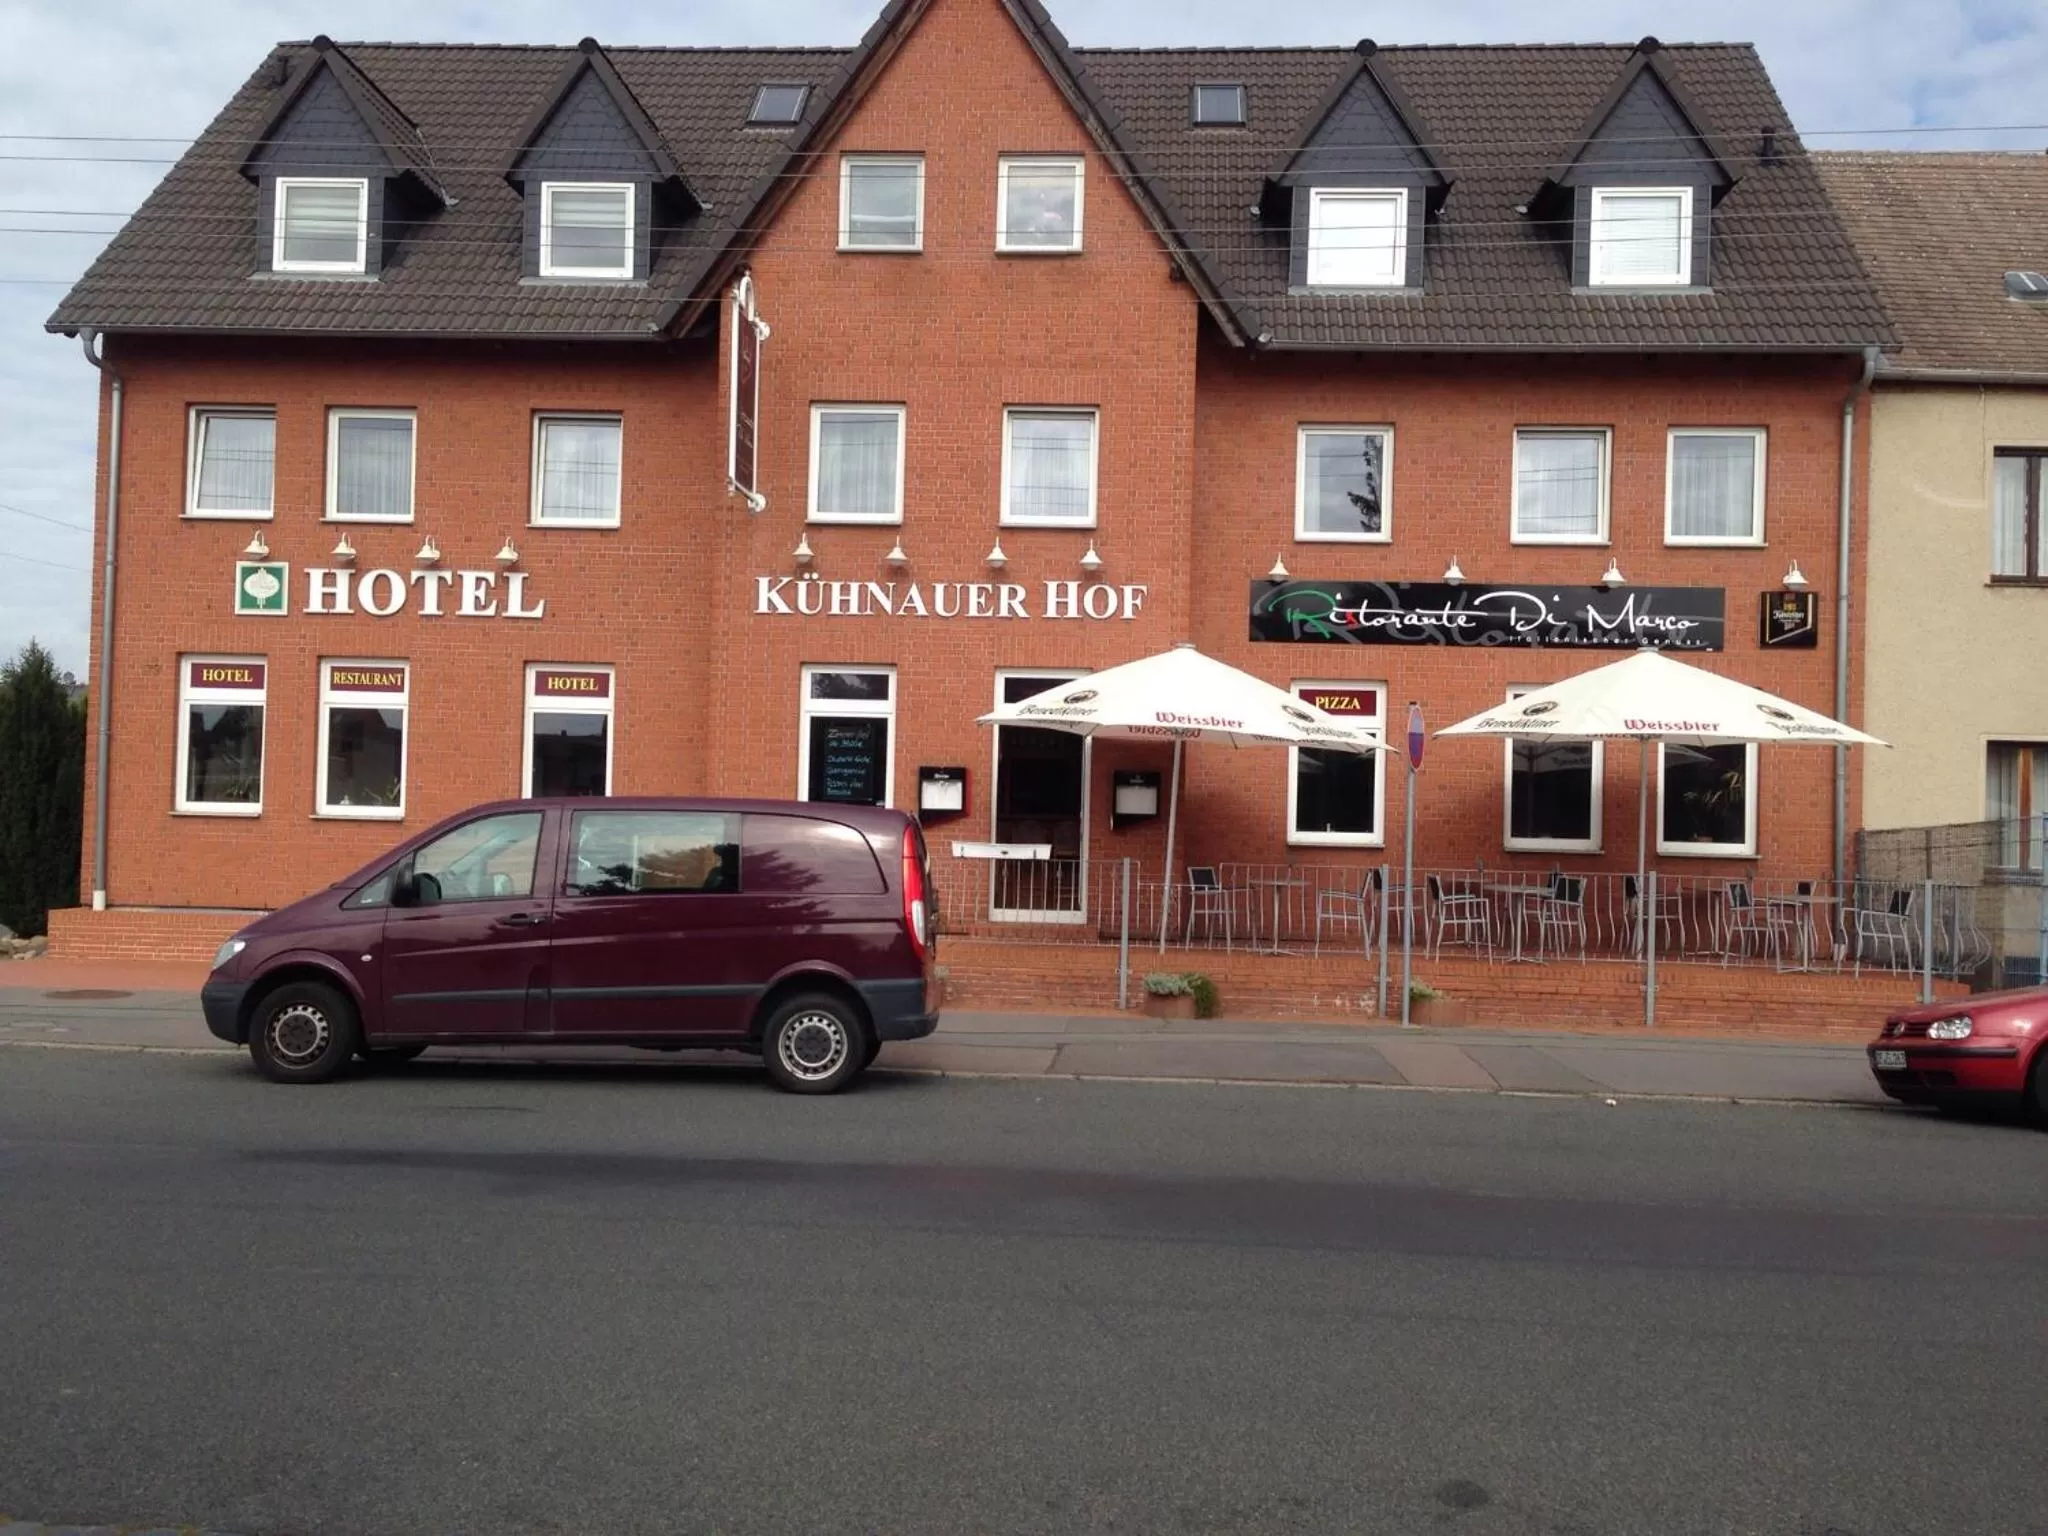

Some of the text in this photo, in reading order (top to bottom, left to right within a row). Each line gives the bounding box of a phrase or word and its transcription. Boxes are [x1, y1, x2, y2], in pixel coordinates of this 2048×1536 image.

[303, 567, 545, 618] HOTEL
[753, 571, 1149, 621] KÜHNAUER HOF
[1268, 589, 1699, 639] Ristorante Di Marco
[202, 668, 253, 683] HOTEL
[333, 671, 404, 687] RESTAURANT
[547, 676, 599, 691] HOTEL
[1314, 695, 1361, 711] PIZZA
[1155, 711, 1245, 730] Weissbier
[1623, 719, 1720, 732] Weissbier
